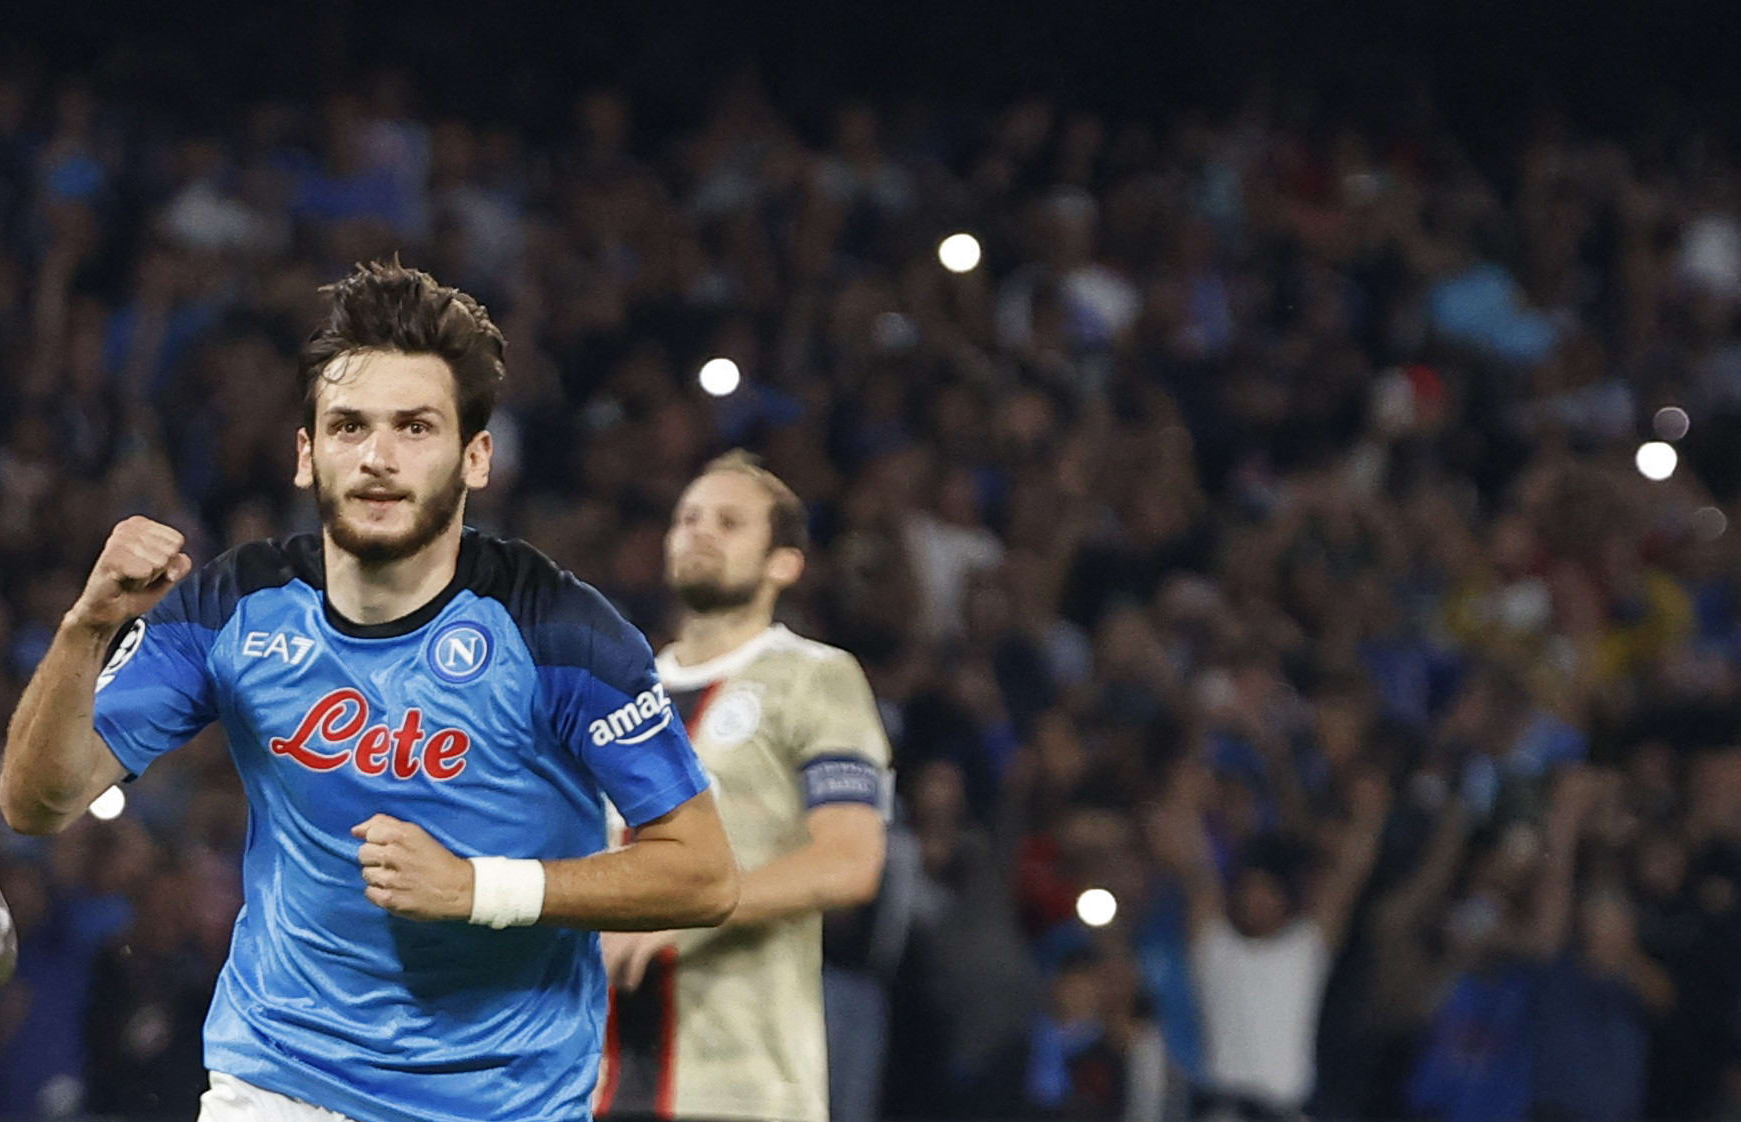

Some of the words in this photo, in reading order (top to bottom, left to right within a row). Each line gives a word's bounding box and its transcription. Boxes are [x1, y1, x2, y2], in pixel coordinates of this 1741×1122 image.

[243, 630, 315, 665] EA7
[441, 637, 475, 667] N
[271, 688, 471, 780] Lete
